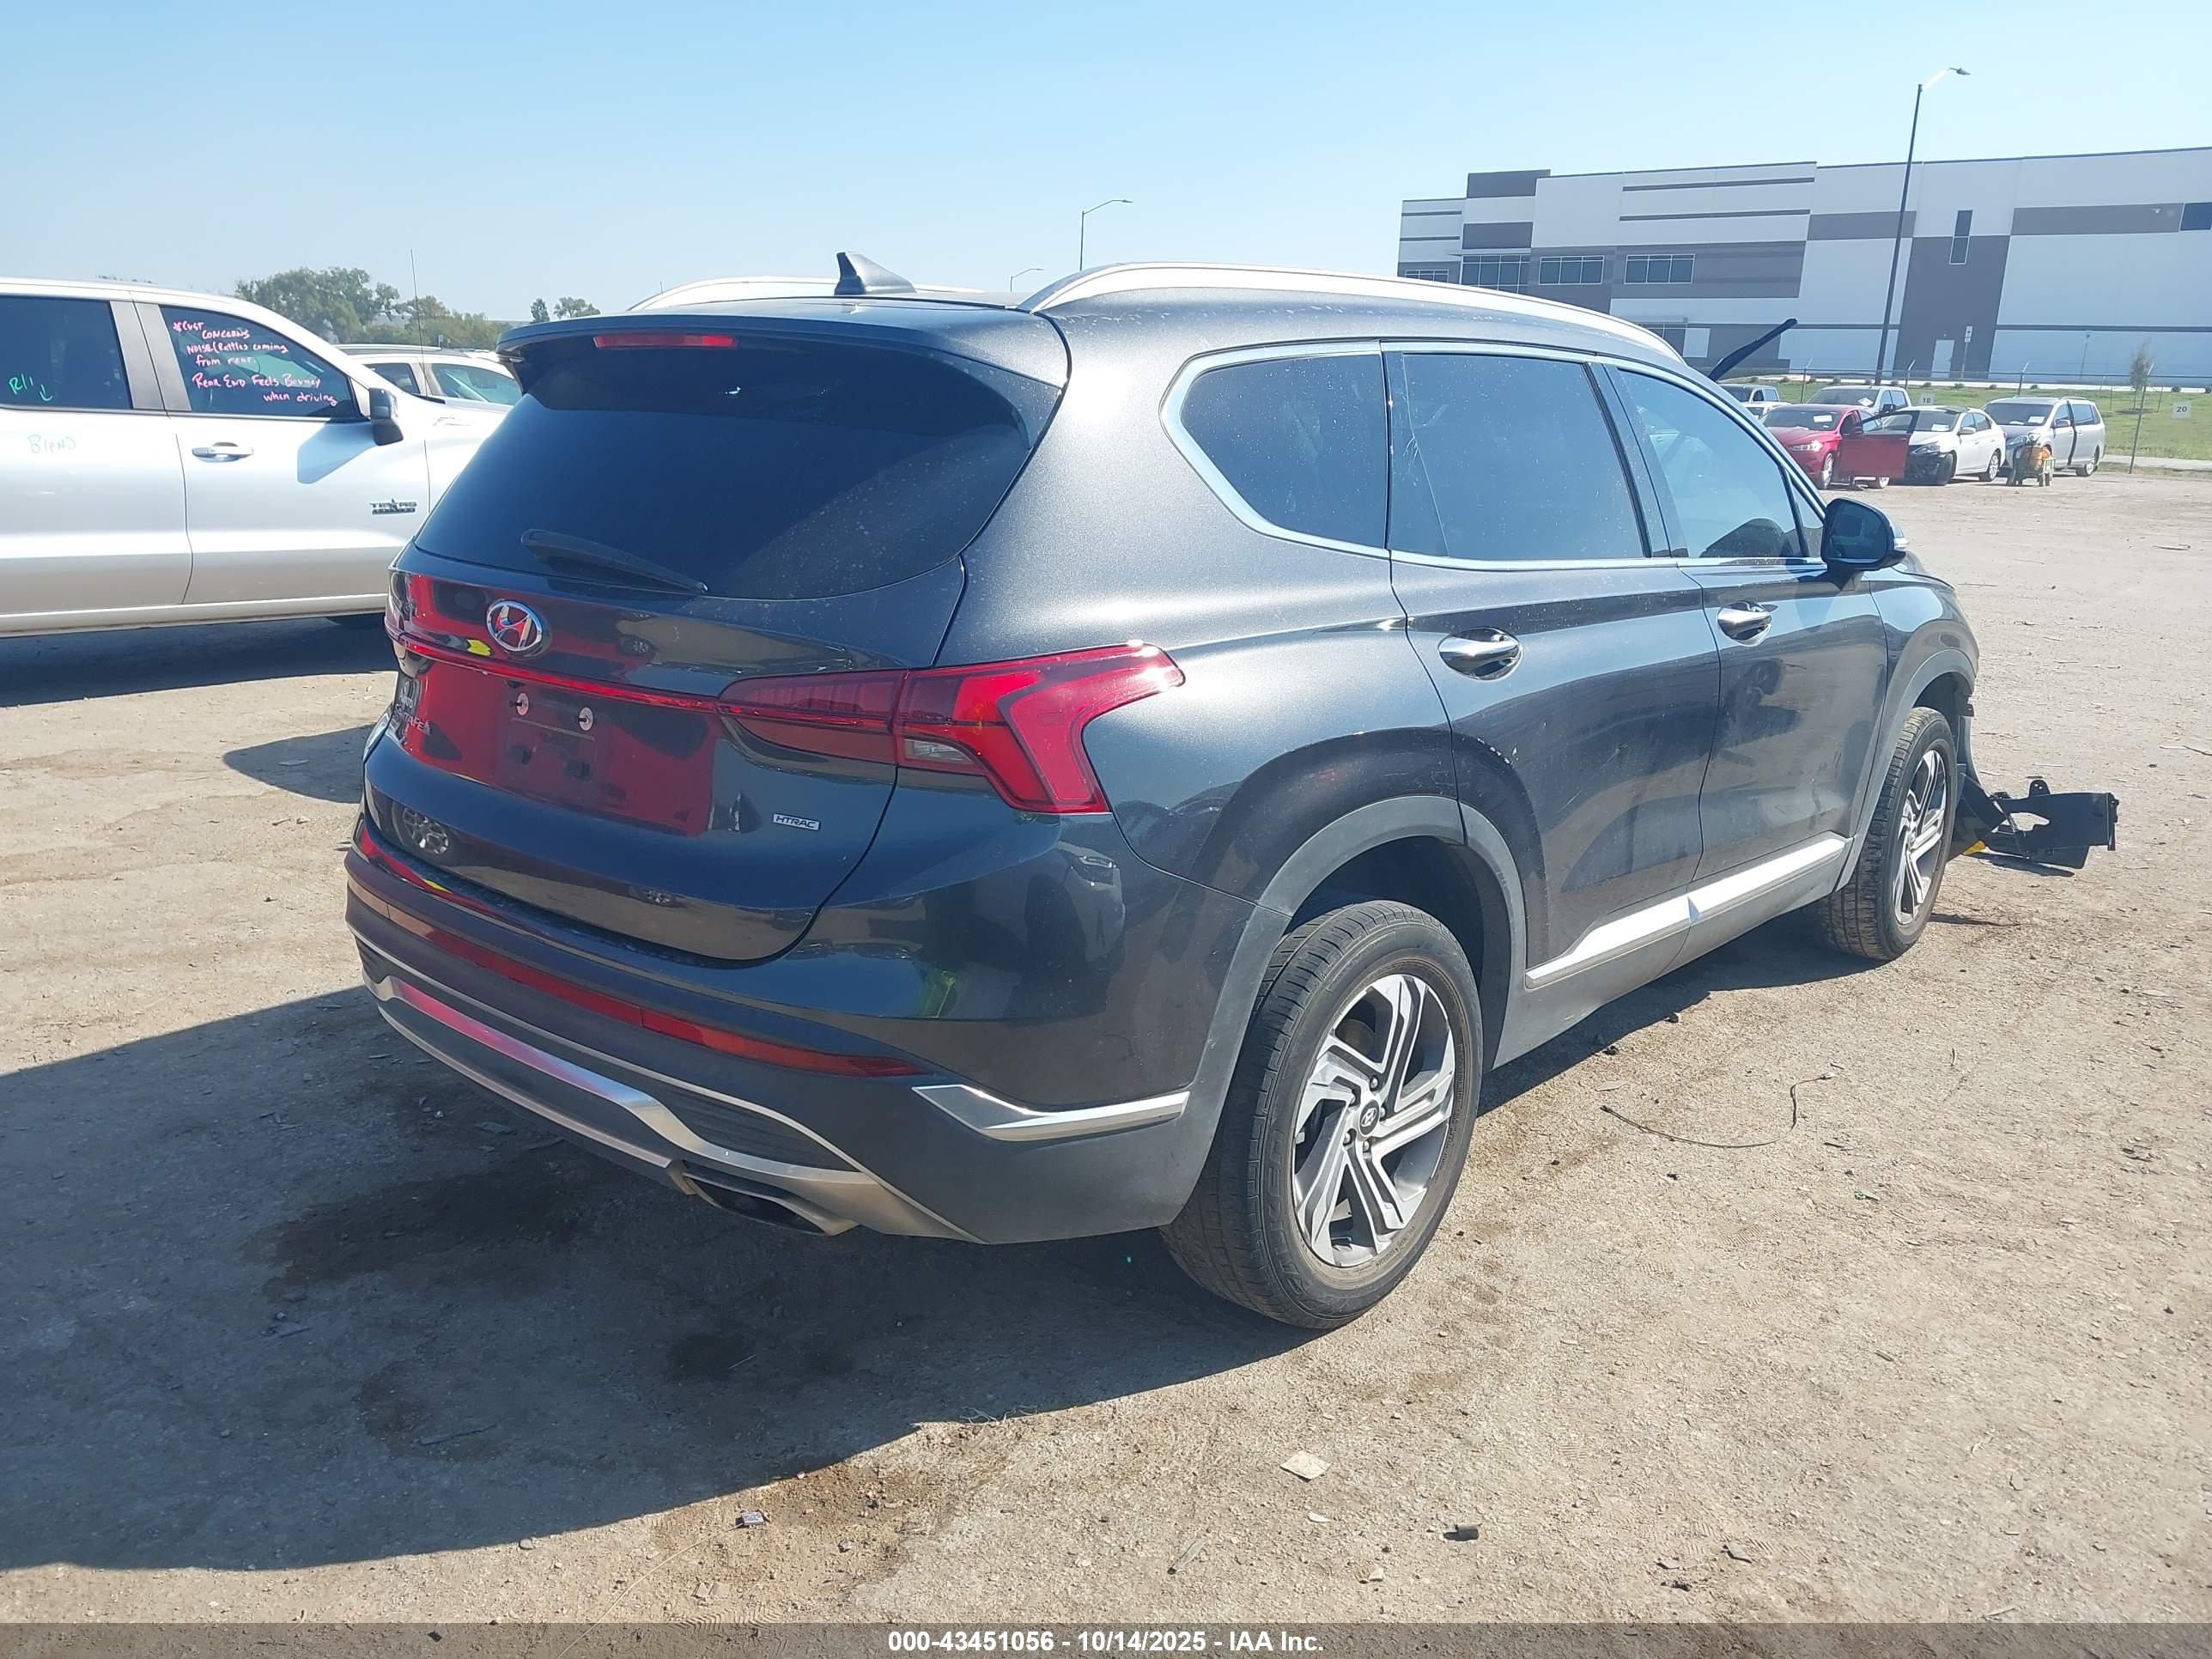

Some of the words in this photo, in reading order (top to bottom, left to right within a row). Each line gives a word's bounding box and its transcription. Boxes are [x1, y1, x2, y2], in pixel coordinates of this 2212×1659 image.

[252, 343, 289, 354] coming
[195, 354, 221, 367] from
[263, 390, 291, 402] when
[296, 391, 338, 407] driving
[775, 815, 817, 829] HTRAC
